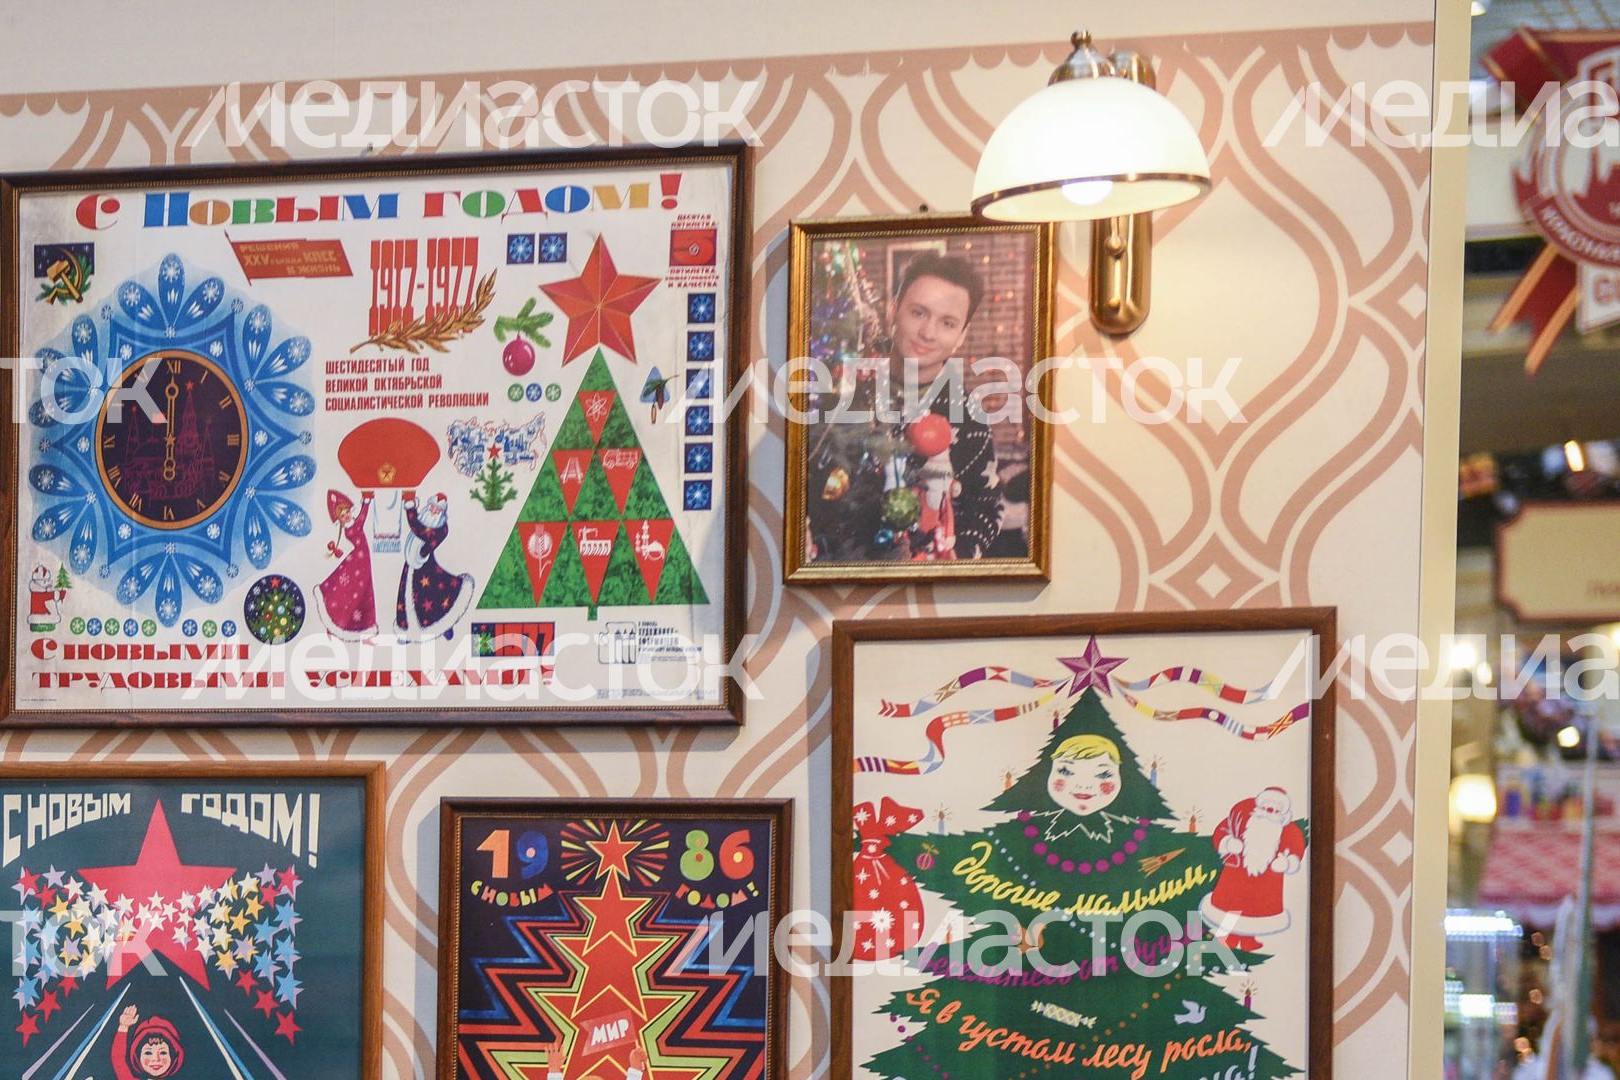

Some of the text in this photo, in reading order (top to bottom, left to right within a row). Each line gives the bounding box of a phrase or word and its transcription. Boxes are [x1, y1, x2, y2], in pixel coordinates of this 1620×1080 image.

[75, 193, 120, 230] С
[368, 236, 479, 336] 1917-1977
[325, 356, 430, 375] ШЕСТИДЕСЯТЫЙ ГОД
[325, 375, 442, 393] ВЕЛИКОЙ ОКТЯБРЬСКОЙ
[325, 392, 489, 412] СОЦИАЛИСТИЧЕСКОЙ РЕВОЛЮЦИИ
[30, 638, 58, 661] С
[32, 671, 286, 694] ТРУДОВЫМИ
[181, 793, 320, 869] ГОДОМ!
[951, 840, 1217, 916] Дорогие малыши,
[675, 880, 760, 909] ГОДОМ!
[590, 1019, 630, 1047] МИР
[906, 988, 940, 1016] Я
[934, 999, 962, 1025] в
[957, 1012, 1075, 1064] густом
[1159, 1027, 1252, 1073] росла,
